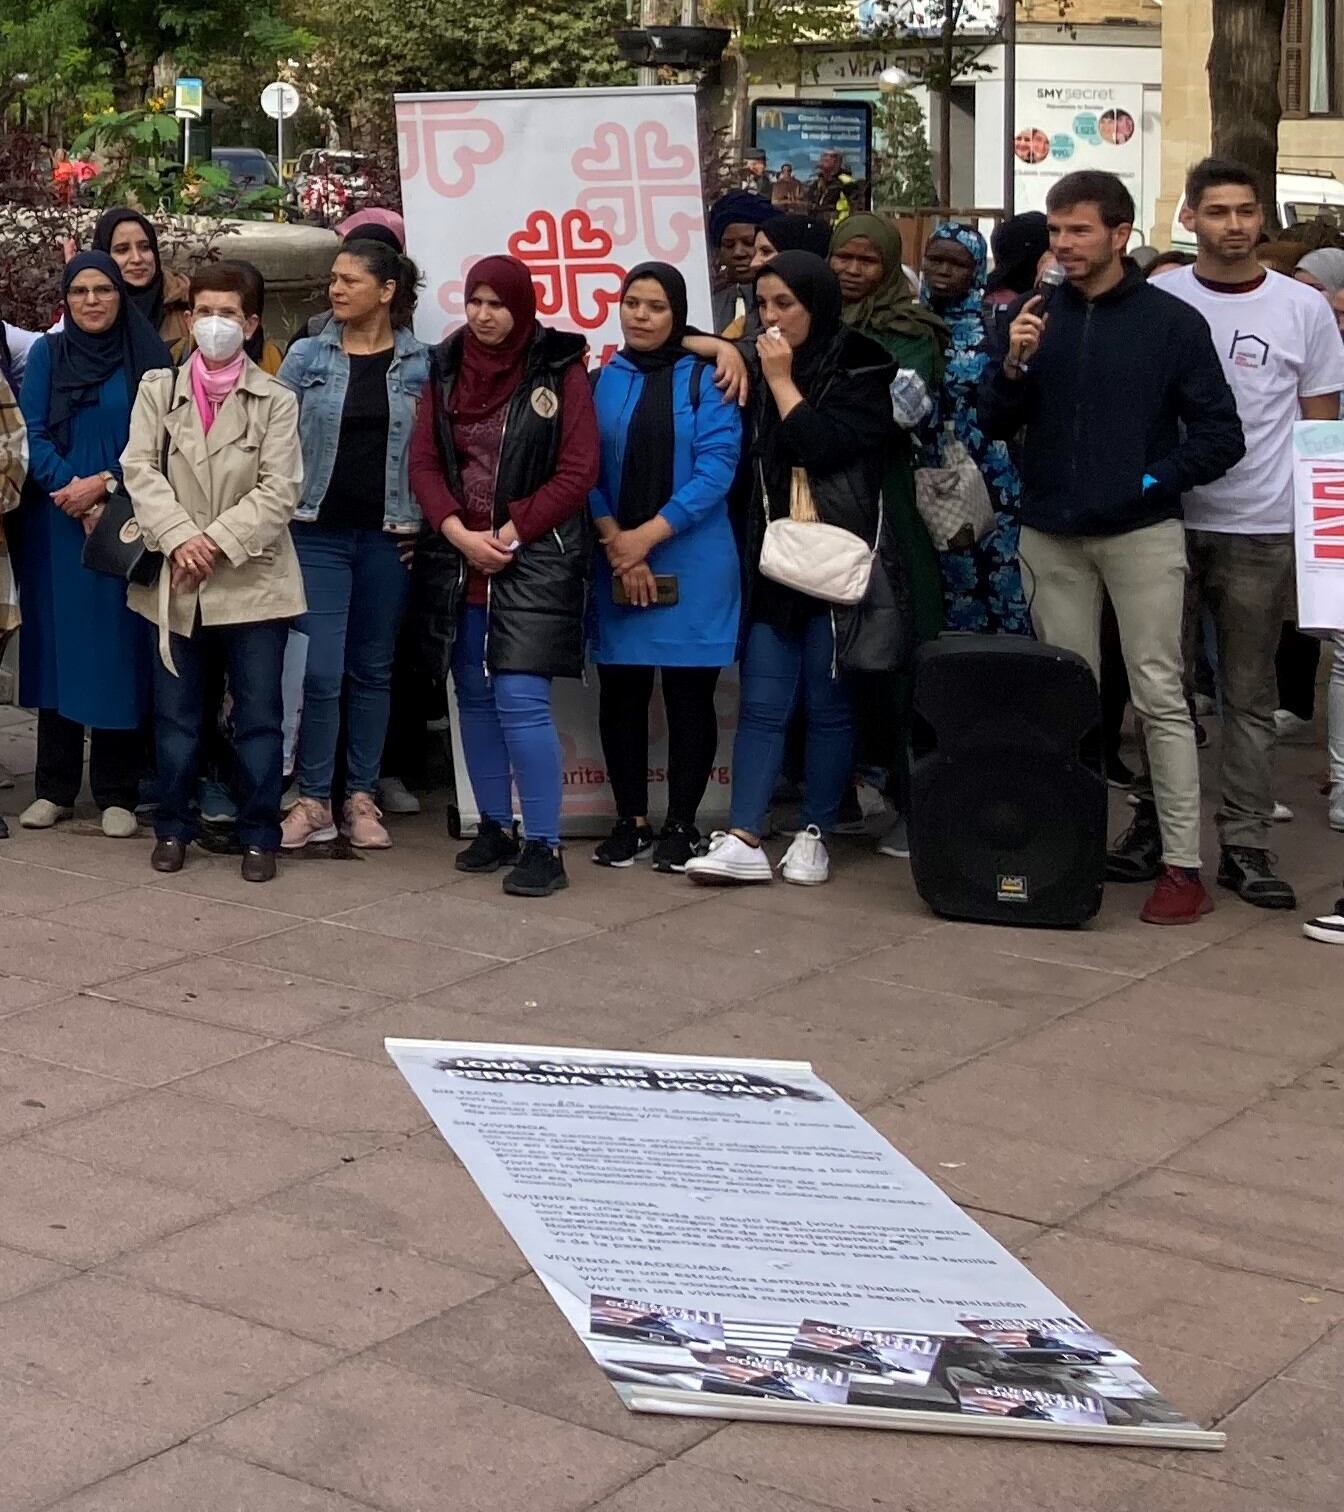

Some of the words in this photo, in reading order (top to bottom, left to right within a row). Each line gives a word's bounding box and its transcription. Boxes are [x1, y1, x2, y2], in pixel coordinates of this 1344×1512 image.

[445, 1069, 592, 1086] PERSONA
[535, 1062, 650, 1079] QUIERE
[653, 1068, 750, 1084] DECIR
